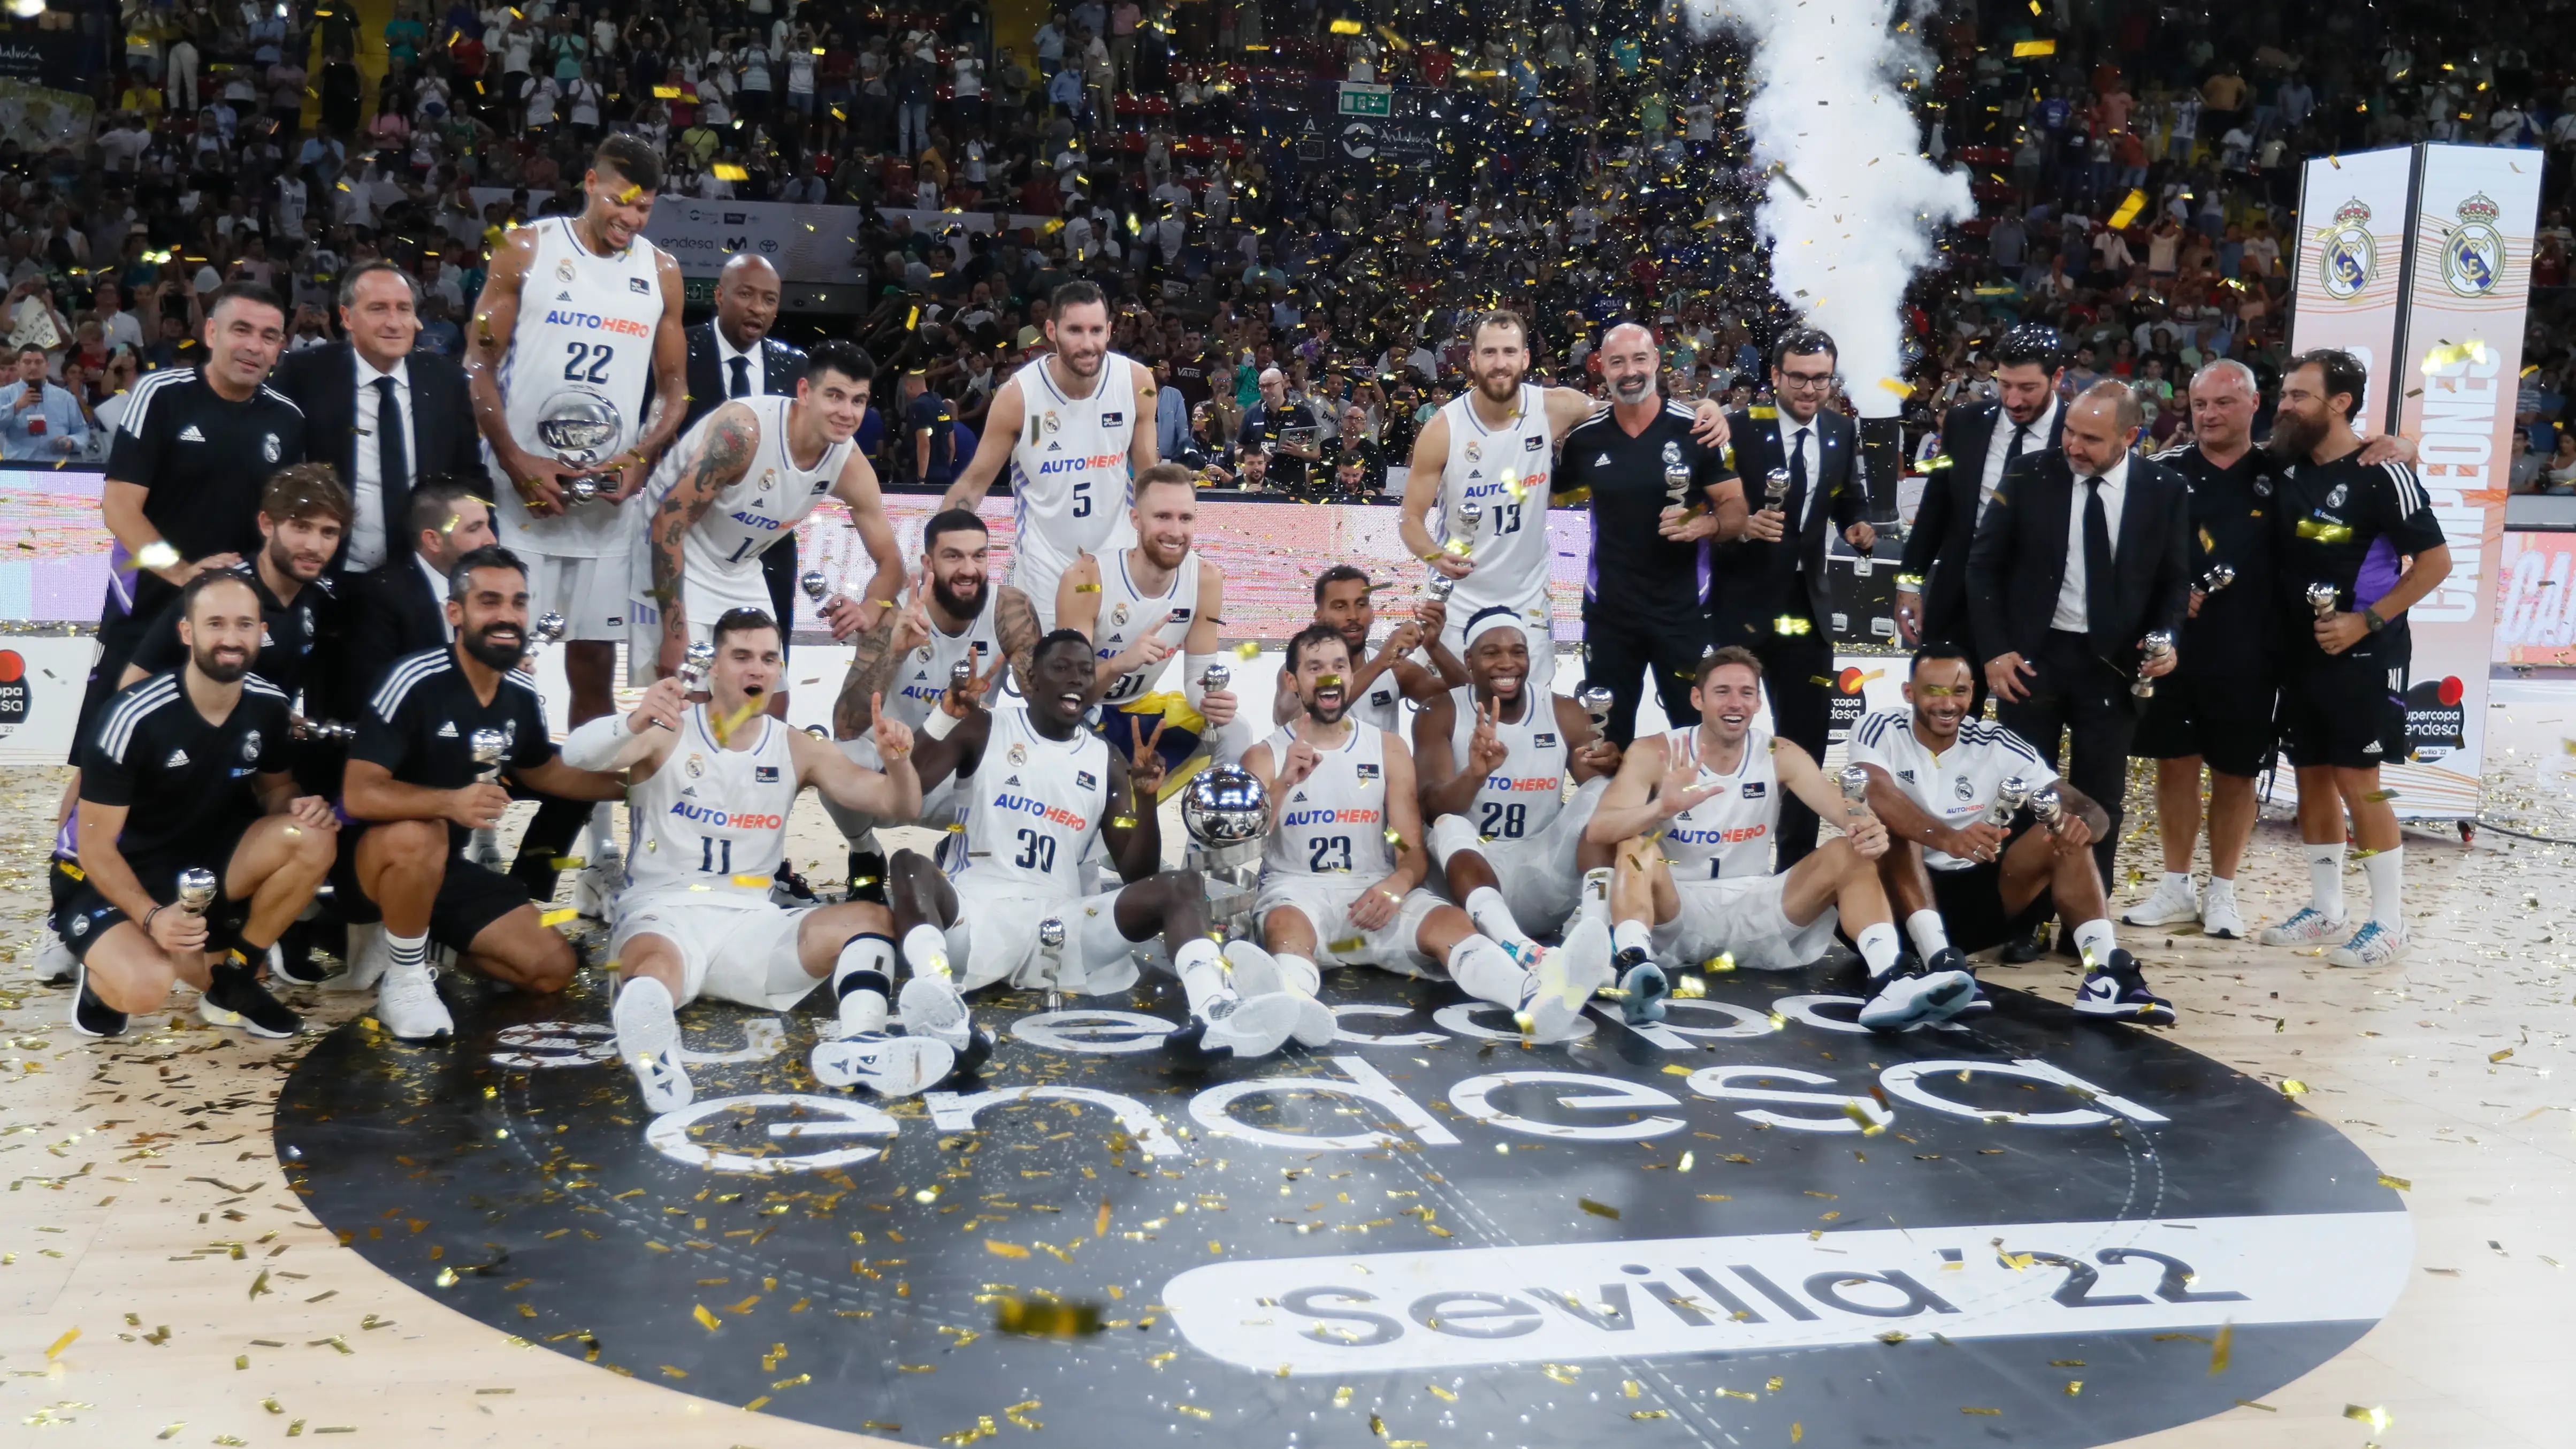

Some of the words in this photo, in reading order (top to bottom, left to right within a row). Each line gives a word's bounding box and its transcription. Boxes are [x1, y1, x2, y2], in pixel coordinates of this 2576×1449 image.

[661, 237, 714, 249] endesa
[1600, 299, 1623, 307] POLO
[545, 309, 649, 338] AUTOHERO
[564, 341, 614, 385] 22
[1177, 367, 1201, 378] VANS
[1463, 472, 1547, 499] AUTOERO
[1073, 482, 1091, 518] 5
[1492, 504, 1520, 536] 13
[2320, 512, 2343, 525] Sanitas
[1103, 673, 1146, 699] 31
[167, 759, 190, 767] adidas
[2417, 748, 2437, 756] Sevilla
[1487, 776, 1557, 791] TOHERO
[669, 801, 782, 830] AUTOHERO
[993, 794, 1087, 832] AUTOHERO
[1284, 810, 1380, 826] AUTOHERO
[1479, 802, 1526, 838] 28
[1946, 804, 1985, 814] AUTOHERO
[1668, 824, 1766, 844] AUTOHERO
[697, 836, 731, 875] 11
[1015, 828, 1056, 874] 30
[1309, 836, 1352, 873] 23
[1709, 857, 1720, 879] 1
[645, 1055, 2171, 1172] endesa
